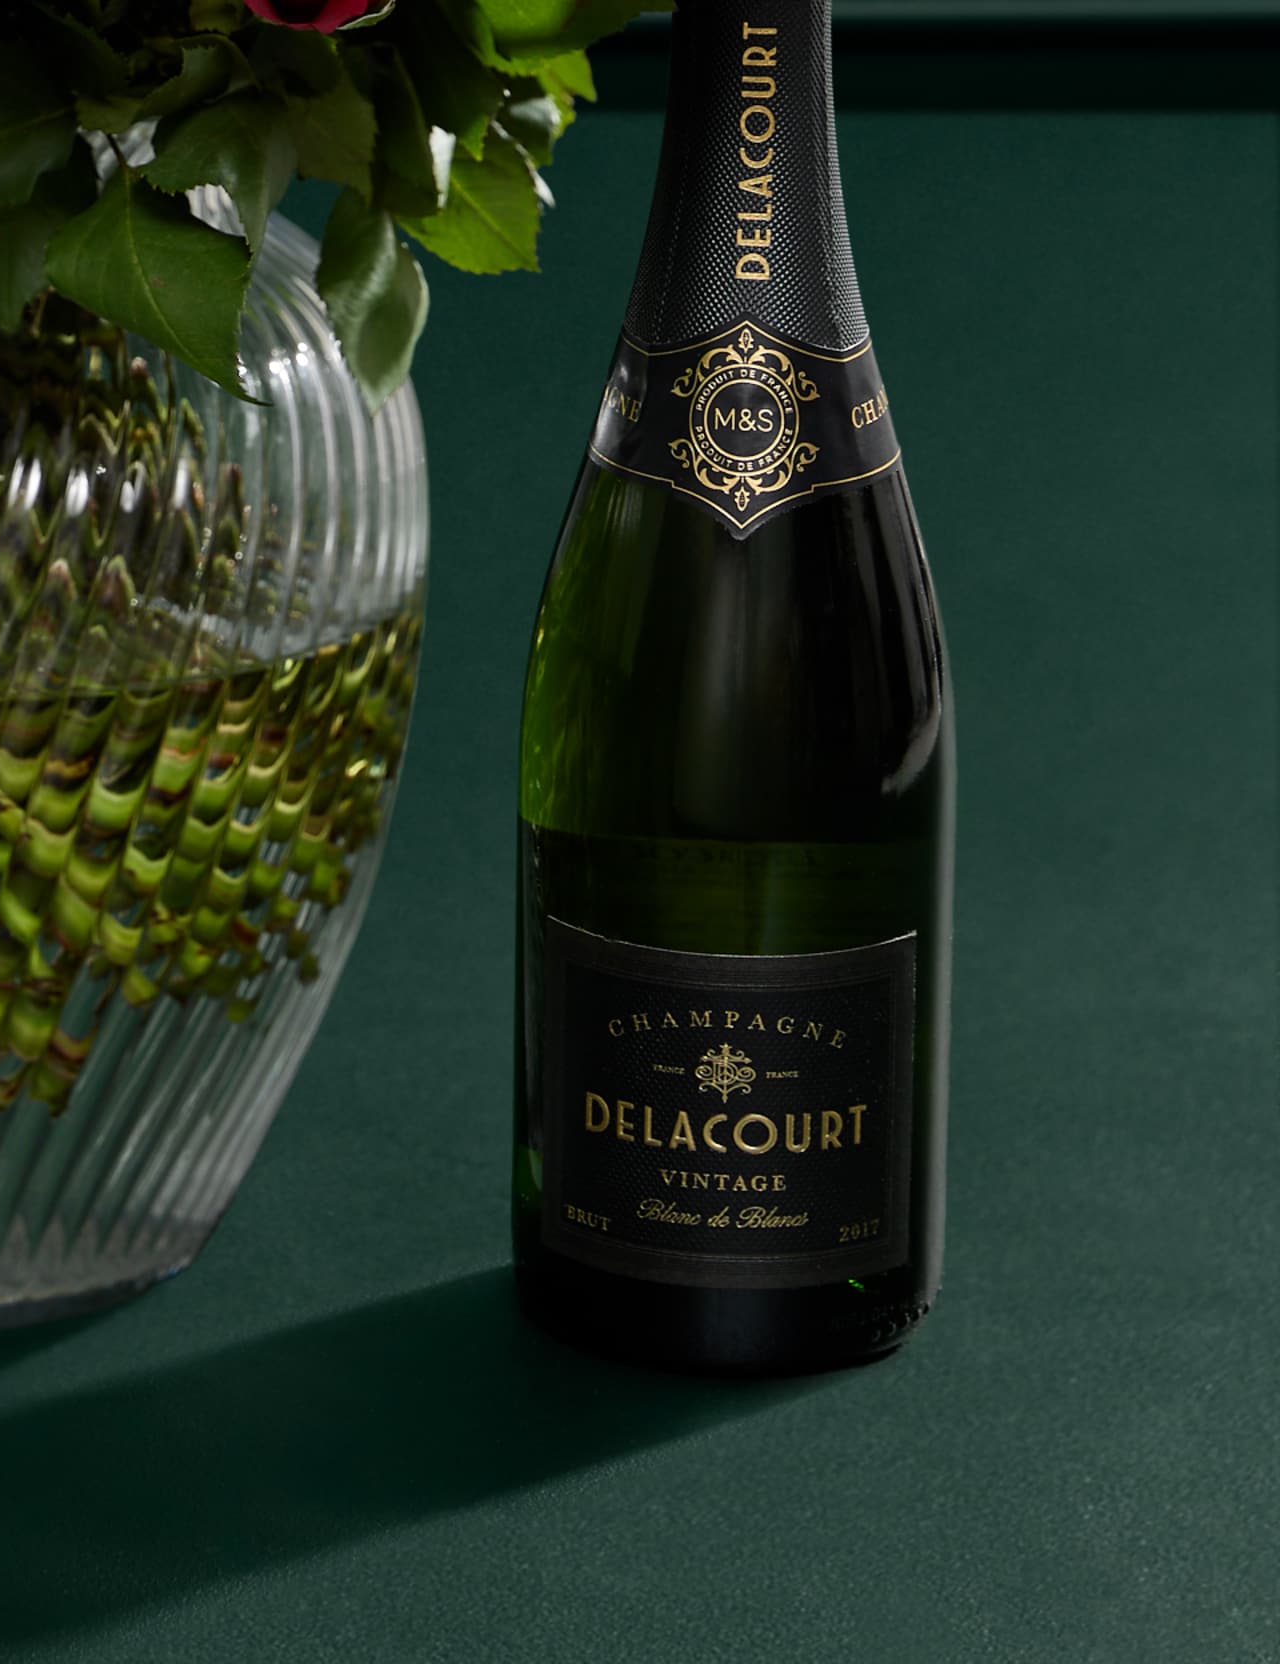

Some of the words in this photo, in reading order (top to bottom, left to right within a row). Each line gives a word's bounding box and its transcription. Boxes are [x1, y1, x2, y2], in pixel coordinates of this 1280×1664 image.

[735, 22, 778, 281] DELACOURT
[695, 370, 735, 411] PRODUIT
[739, 368, 756, 379] DE
[759, 373, 794, 414] FRANCE
[714, 407, 774, 433] M&S
[695, 425, 733, 468] PRODUIT
[737, 461, 755, 471] DE
[758, 427, 793, 468] FRANCE
[607, 1009, 848, 1049] CHAMPAGNE
[584, 1090, 869, 1156] DELACOURT
[658, 1168, 788, 1192] VINTAGE
[563, 1204, 613, 1233] BRUT
[636, 1198, 702, 1227] Blanc
[706, 1205, 731, 1229] de
[838, 1218, 881, 1243] 2017
